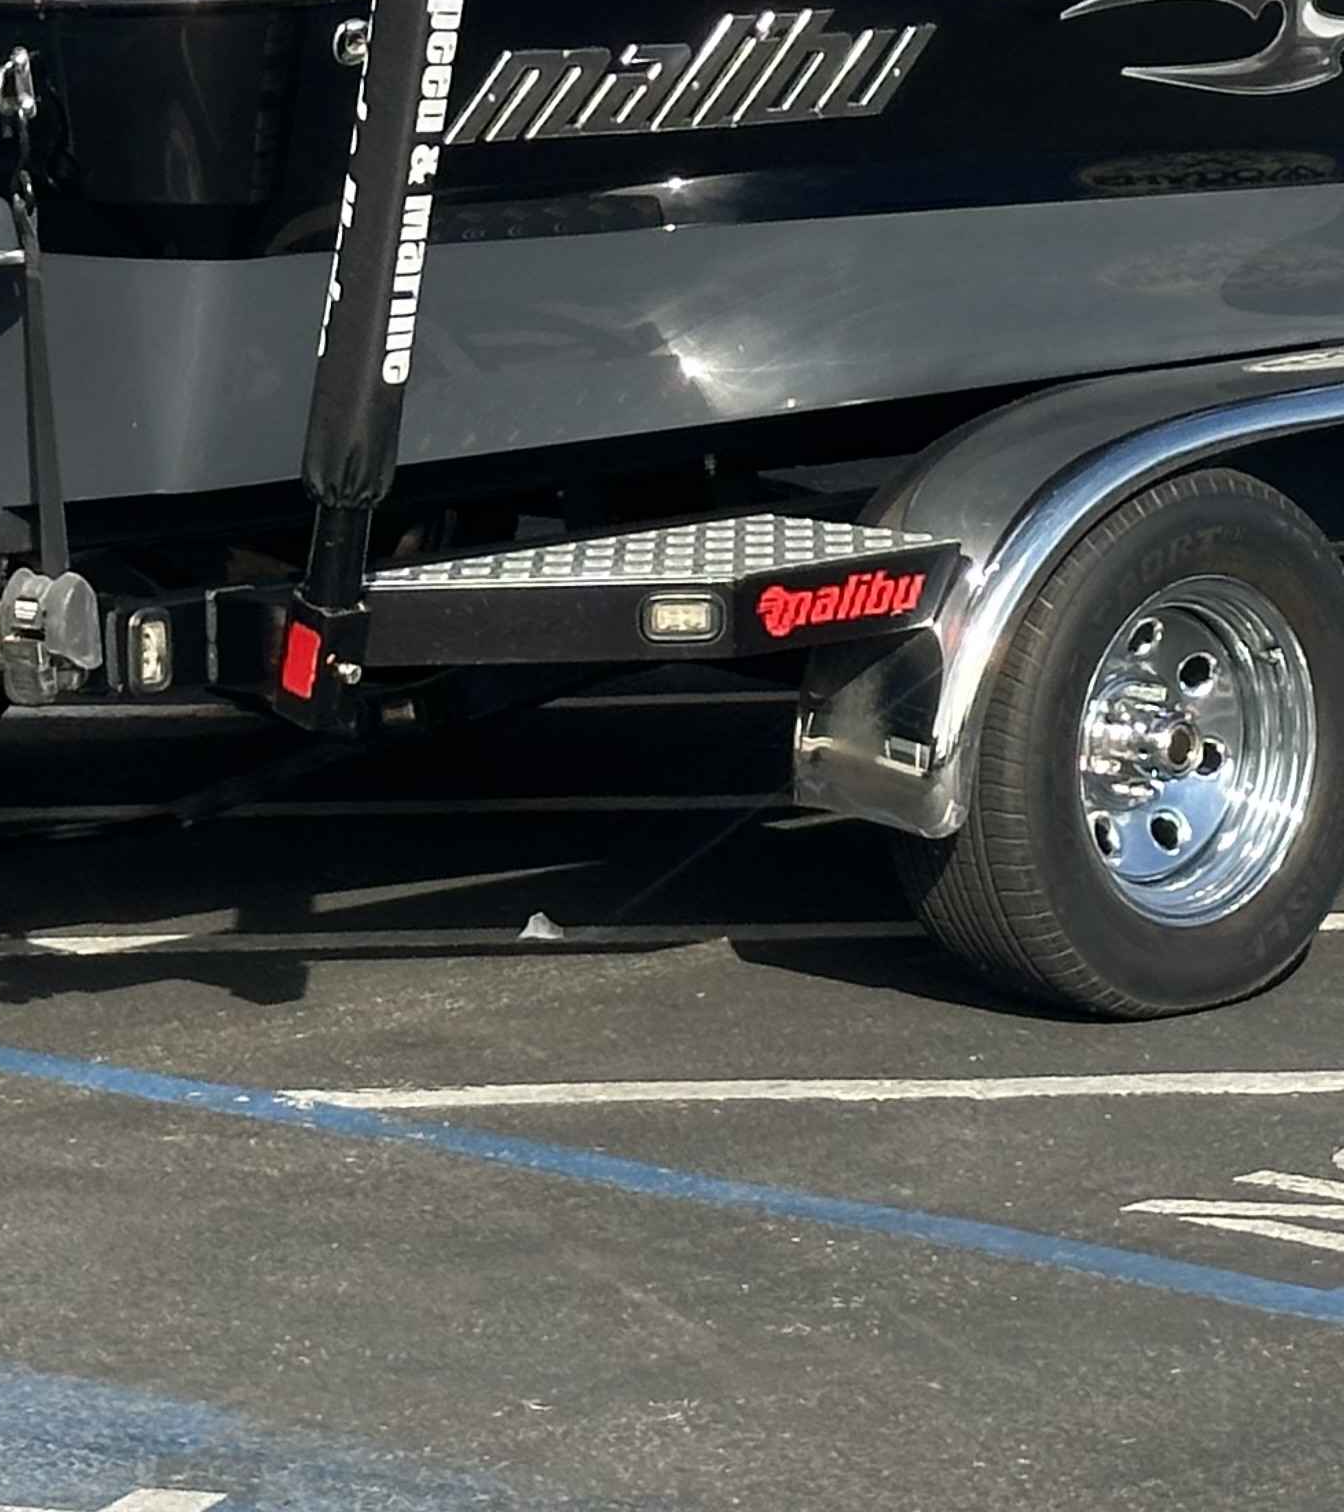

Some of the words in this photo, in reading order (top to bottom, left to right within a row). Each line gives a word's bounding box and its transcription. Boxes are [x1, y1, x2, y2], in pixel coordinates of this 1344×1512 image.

[443, 8, 936, 145] malibu
[407, 142, 443, 186] &
[383, 192, 433, 386] Marine
